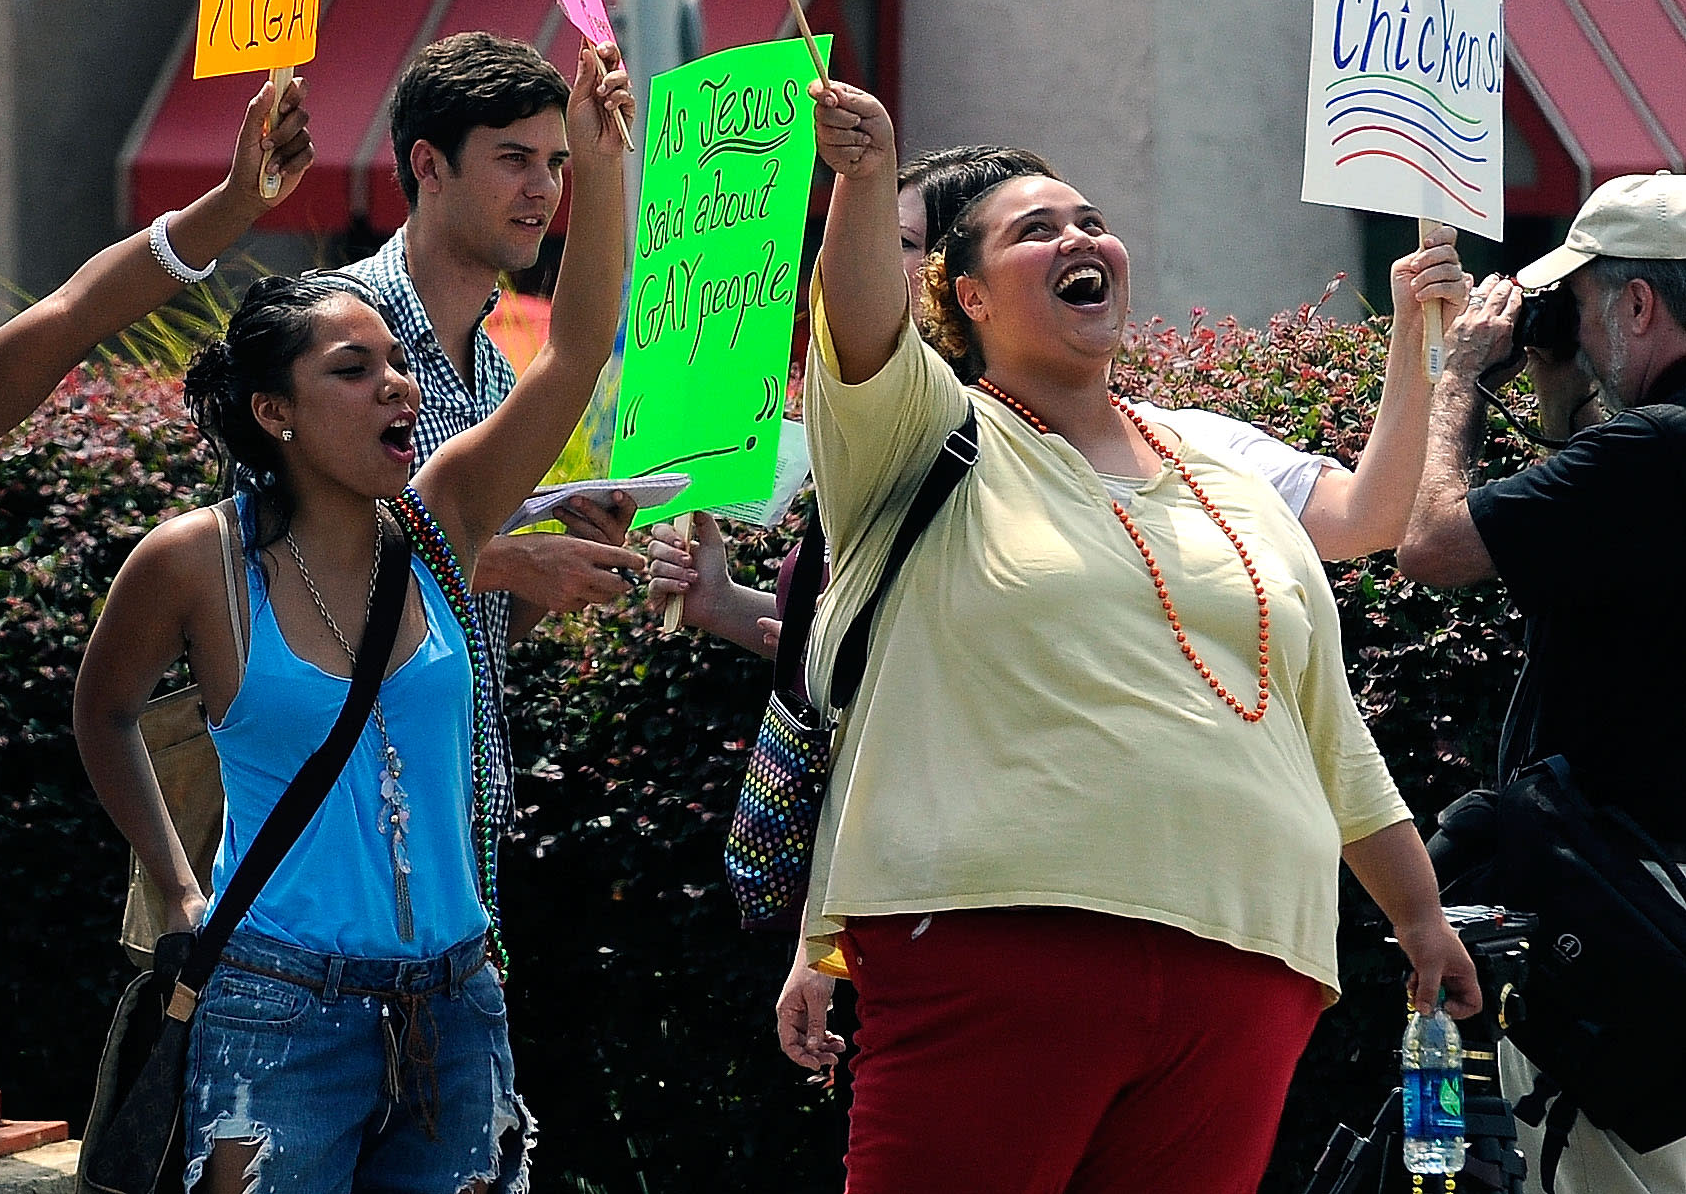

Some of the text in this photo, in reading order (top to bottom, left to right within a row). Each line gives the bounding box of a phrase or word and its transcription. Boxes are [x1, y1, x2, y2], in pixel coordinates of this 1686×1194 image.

[651, 73, 798, 166] As Jesus
[694, 158, 780, 236] about
[635, 253, 703, 350] GAY
